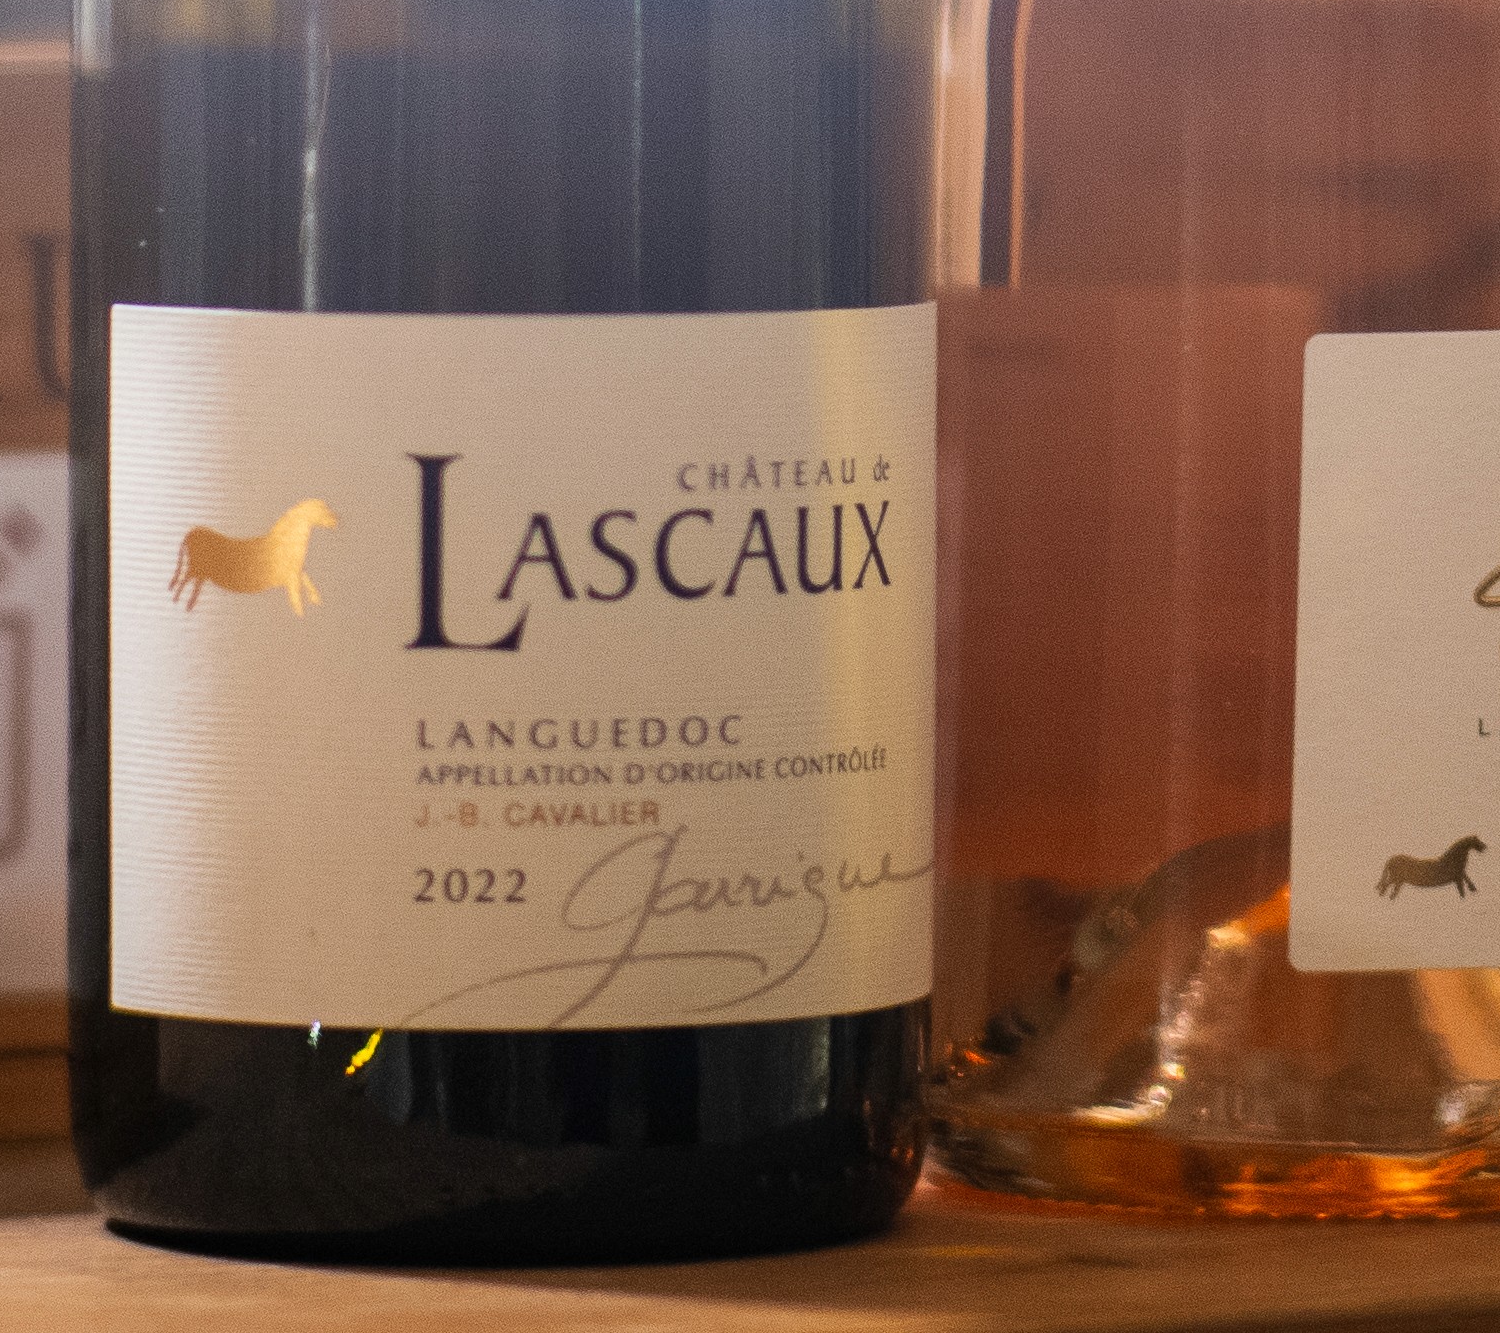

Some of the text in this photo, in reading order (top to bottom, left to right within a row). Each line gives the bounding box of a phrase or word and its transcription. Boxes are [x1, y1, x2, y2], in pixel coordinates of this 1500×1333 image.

[676, 453, 891, 494] CHÂTEAU de
[404, 450, 892, 652] LASCAUX
[415, 715, 743, 751] LANGUEDOC
[417, 762, 613, 787] APPELLATION
[774, 742, 888, 779] CONTRÔLÉE
[504, 799, 660, 828] CAVALIER
[413, 867, 528, 904] 2022
